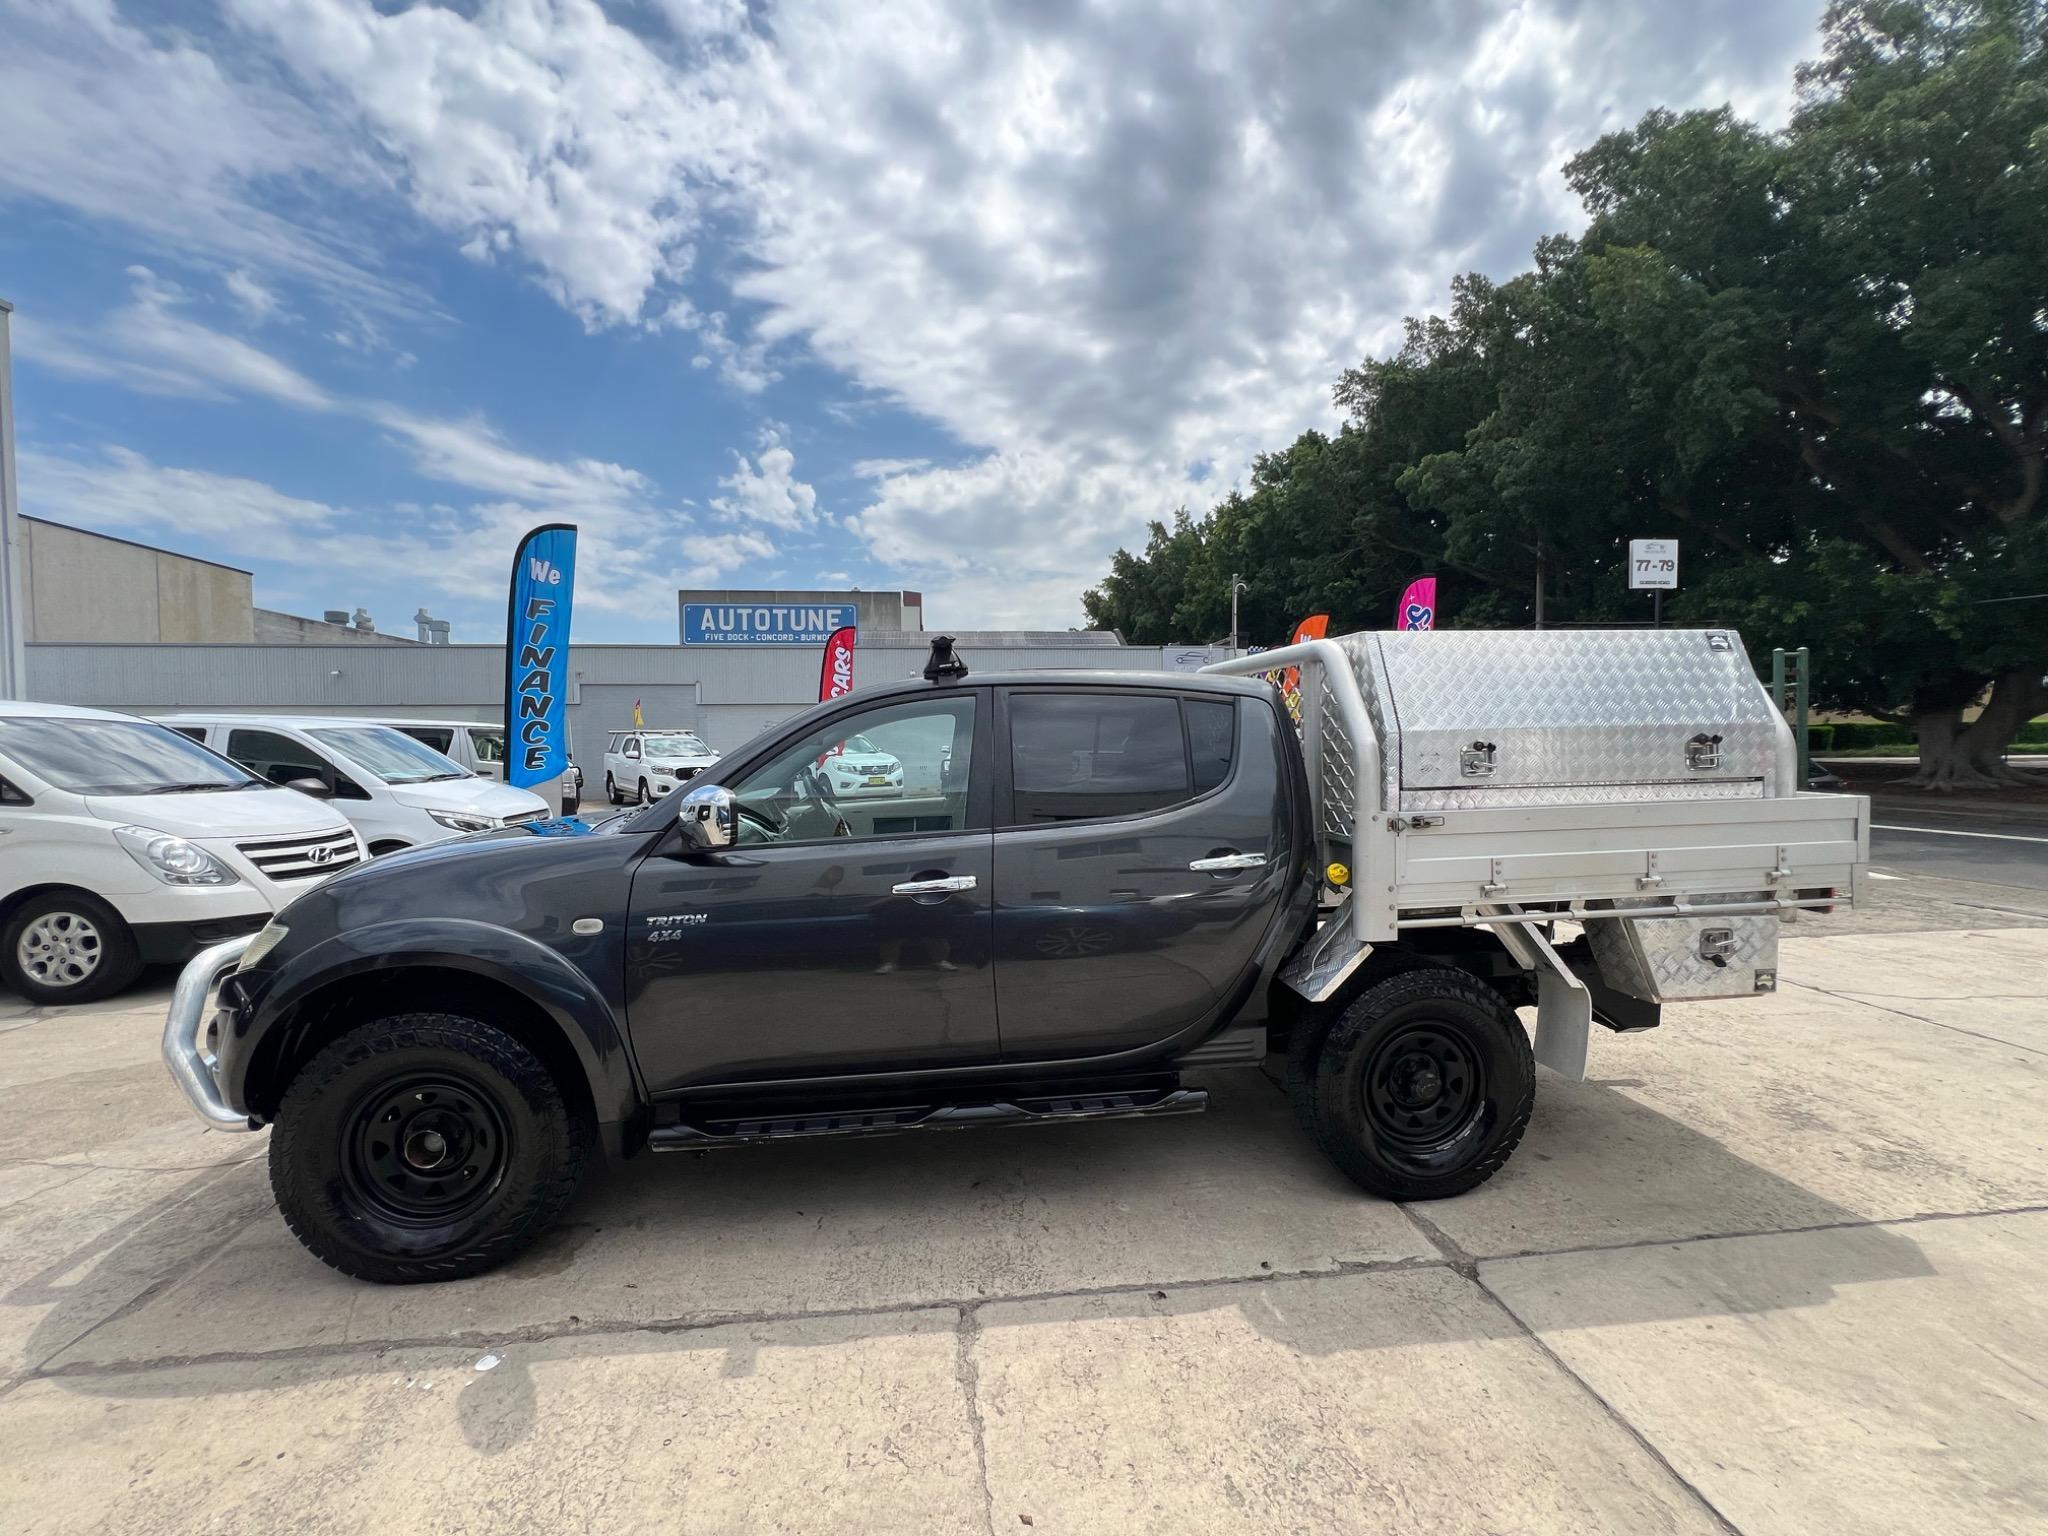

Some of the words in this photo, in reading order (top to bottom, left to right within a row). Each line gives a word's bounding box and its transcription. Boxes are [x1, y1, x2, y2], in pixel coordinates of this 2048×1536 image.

[530, 558, 561, 585] We
[701, 608, 842, 631] AUTOTUNE
[519, 597, 556, 770] FINANCE
[646, 914, 708, 926] TRITON
